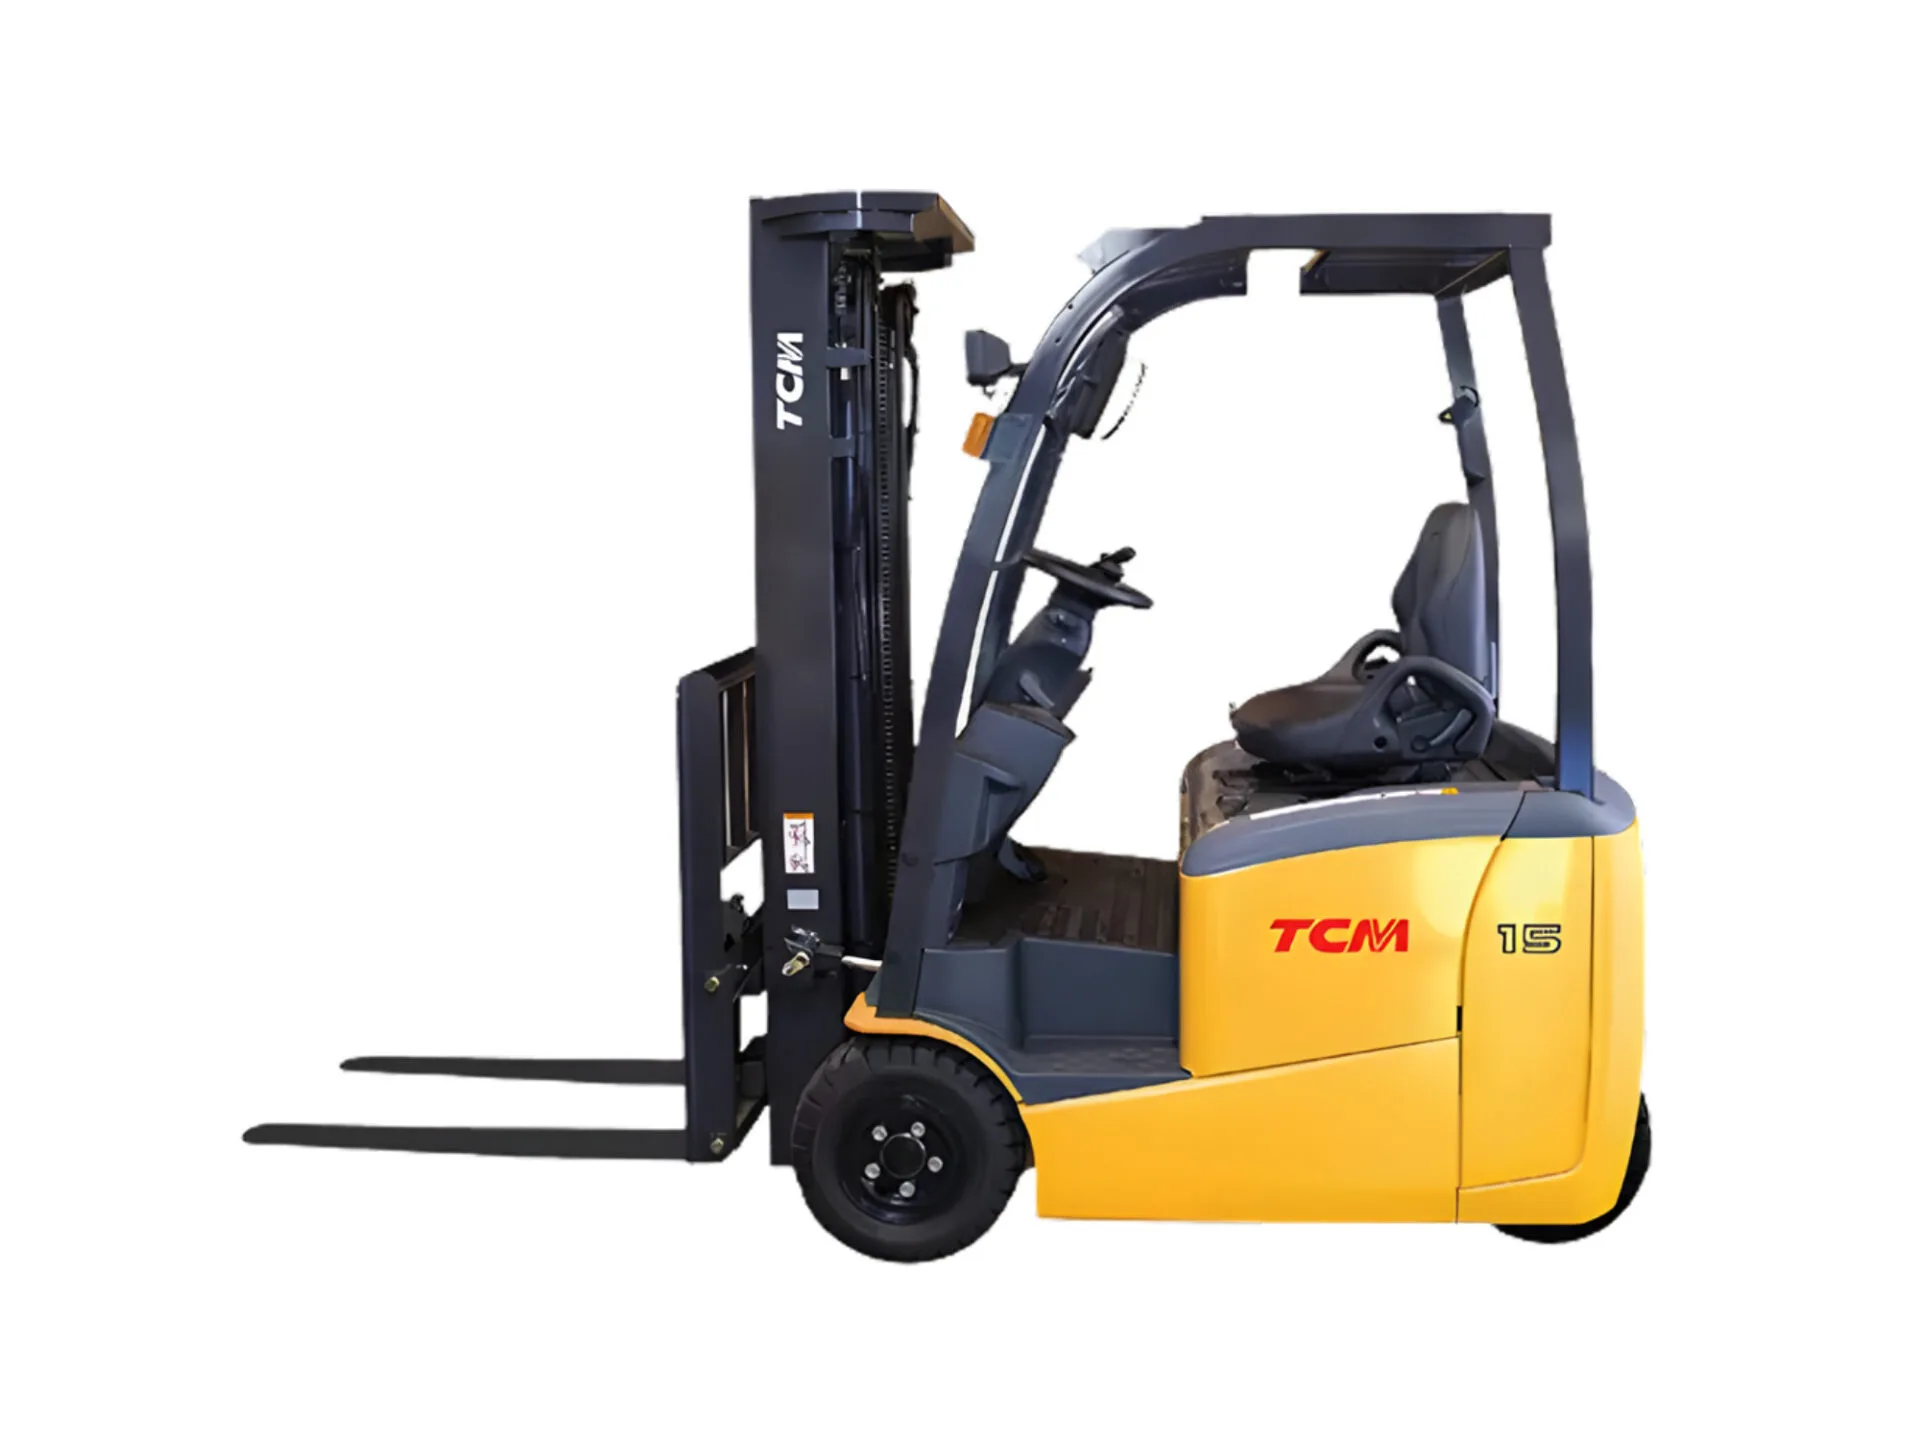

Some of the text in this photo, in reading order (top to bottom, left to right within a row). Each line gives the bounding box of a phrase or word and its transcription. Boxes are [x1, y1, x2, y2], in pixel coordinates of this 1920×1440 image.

[776, 332, 804, 430] TCM
[1269, 918, 1409, 953] TCM
[1497, 923, 1562, 954] 15
